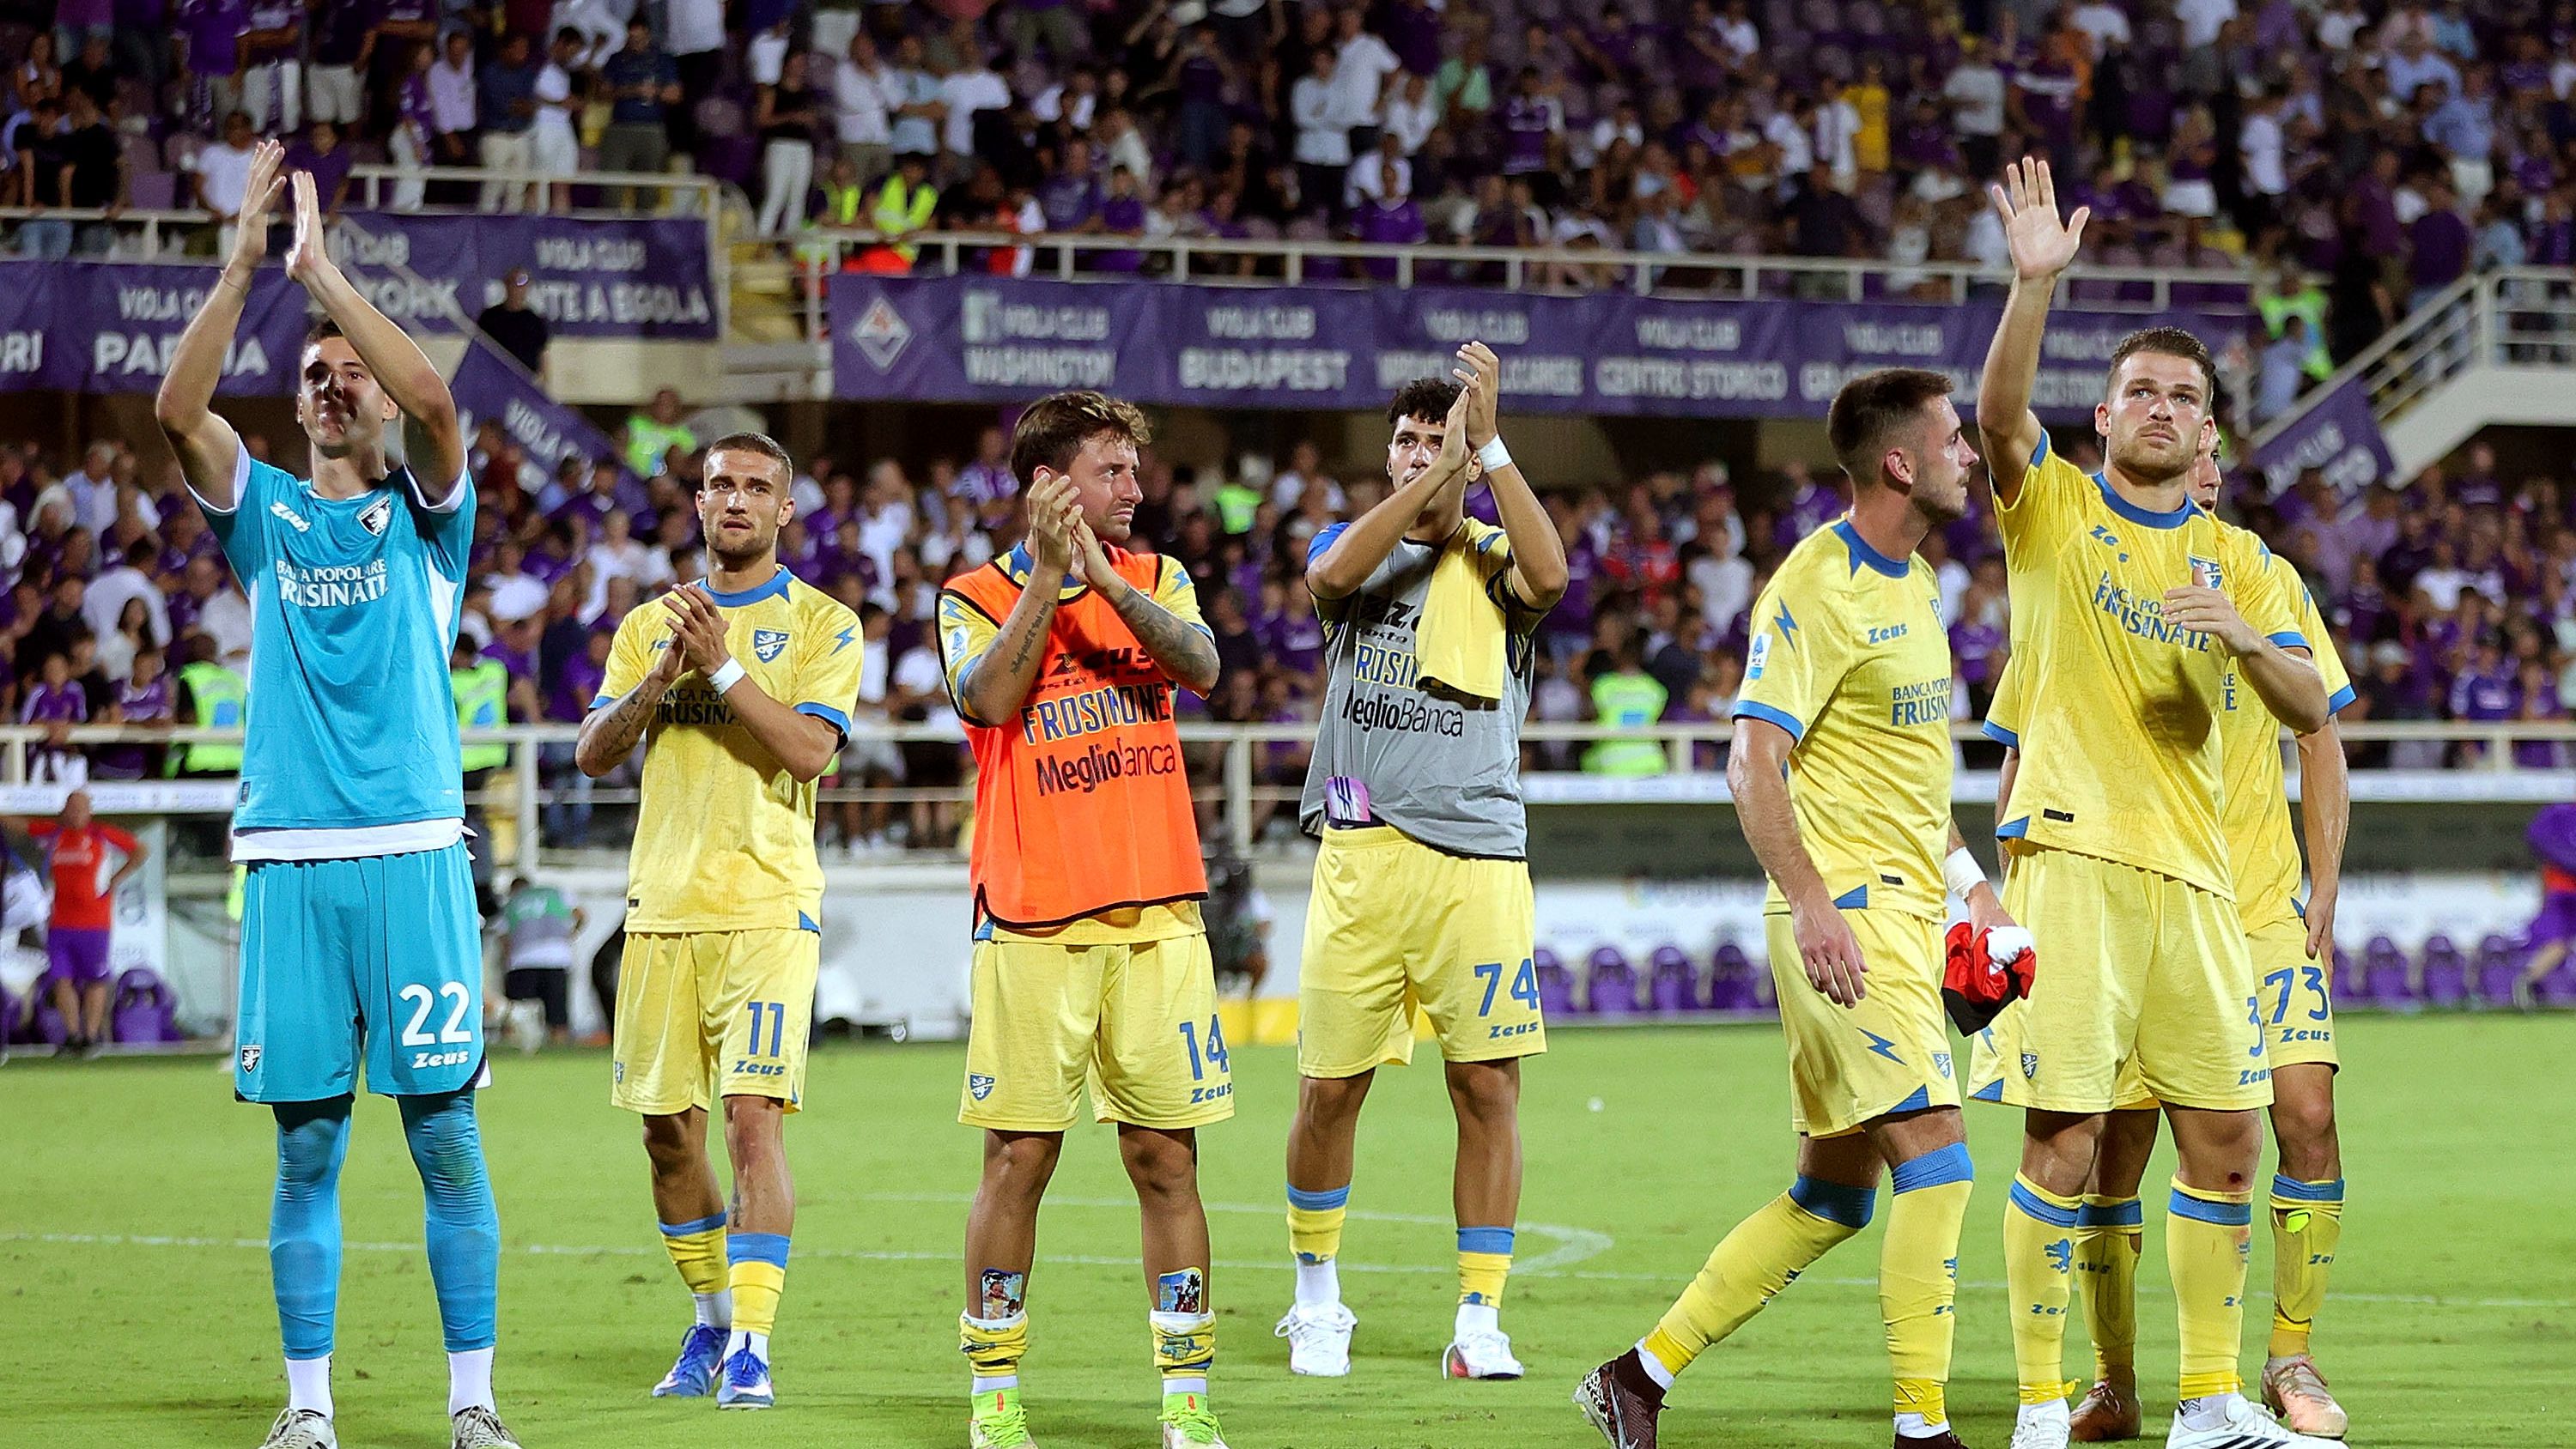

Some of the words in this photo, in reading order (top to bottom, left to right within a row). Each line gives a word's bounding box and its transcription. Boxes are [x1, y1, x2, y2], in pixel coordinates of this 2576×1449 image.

[118, 287, 182, 320] VIOLA
[484, 278, 583, 323] PNTE
[585, 281, 610, 323] A
[94, 331, 270, 375] PAA
[963, 346, 1119, 387] WASHINGTON
[1179, 346, 1352, 391] BUDAPEST
[1595, 355, 1689, 397] CENTRO
[1690, 360, 1789, 401] STORICO
[1868, 622, 1909, 644] Zeus
[1893, 682, 1931, 700] BANCA
[1036, 737, 1177, 797] Meglioanca
[1474, 958, 1539, 1018] 74
[2264, 966, 2329, 1024] 73
[398, 981, 473, 1047] 22
[747, 1001, 785, 1058] 11
[1488, 1022, 1538, 1039] Zeus
[2280, 1028, 2330, 1044] Zeus
[412, 1049, 470, 1070] Zeus
[733, 1060, 786, 1076] Zeus
[1180, 1013, 1229, 1082] 14
[1190, 1082, 1233, 1105] Zeus
